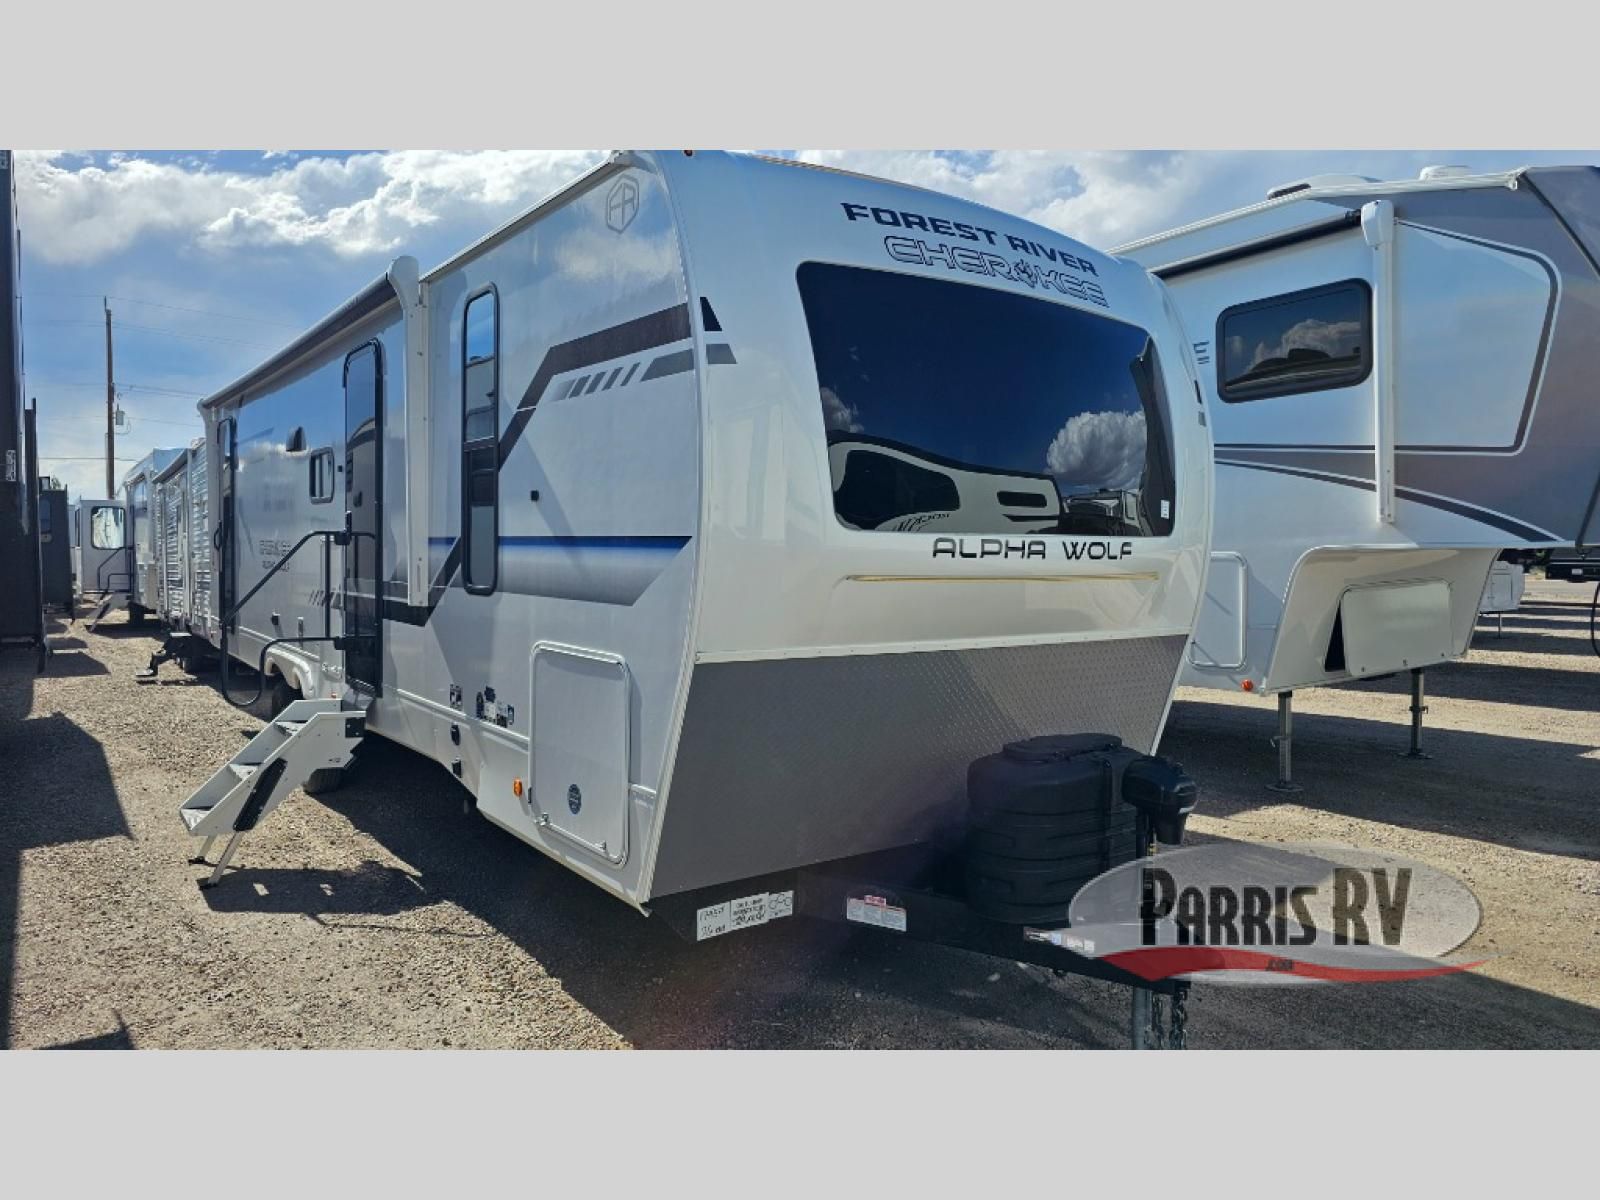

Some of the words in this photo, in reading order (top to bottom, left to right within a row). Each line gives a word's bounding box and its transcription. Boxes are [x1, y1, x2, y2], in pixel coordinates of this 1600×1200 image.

[841, 202, 998, 245] FOREST
[1004, 233, 1099, 277] RIVER
[884, 235, 1110, 308] CHEROKEE
[932, 537, 1046, 559] ALPHA
[1062, 541, 1133, 560] WOLF
